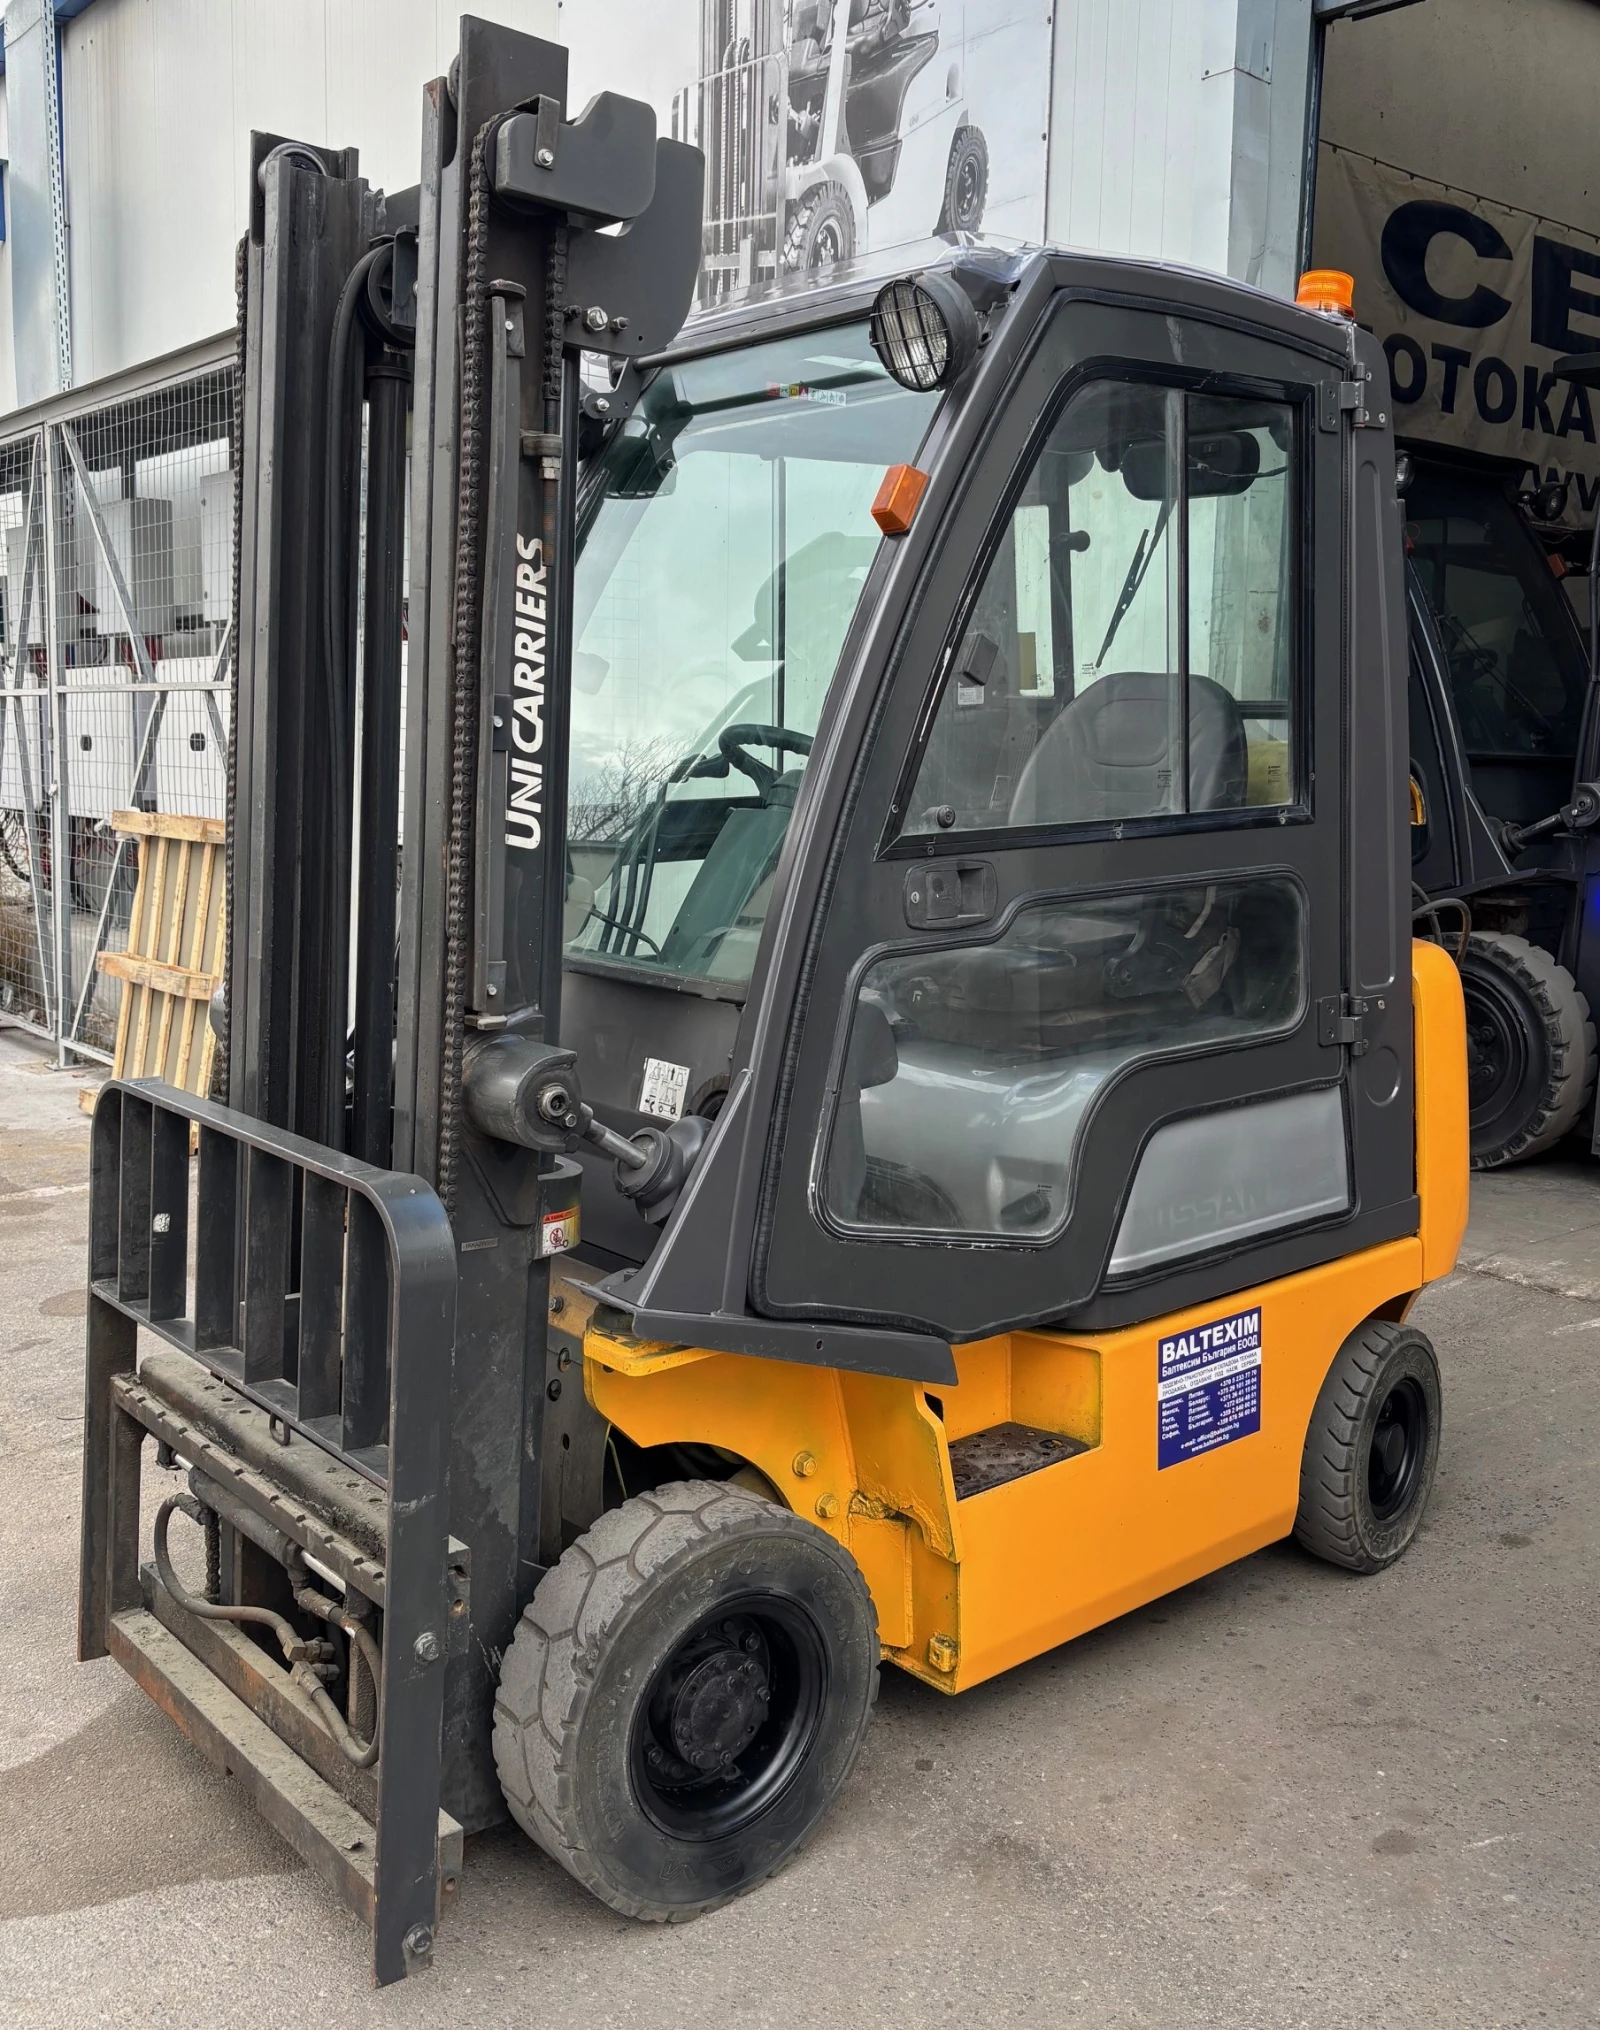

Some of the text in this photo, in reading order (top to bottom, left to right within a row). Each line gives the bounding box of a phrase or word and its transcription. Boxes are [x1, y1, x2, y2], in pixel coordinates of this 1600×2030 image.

[1162, 1335, 1258, 1377] Балтексим България ЕООД
[1163, 1314, 1258, 1363] BALTEXIM
